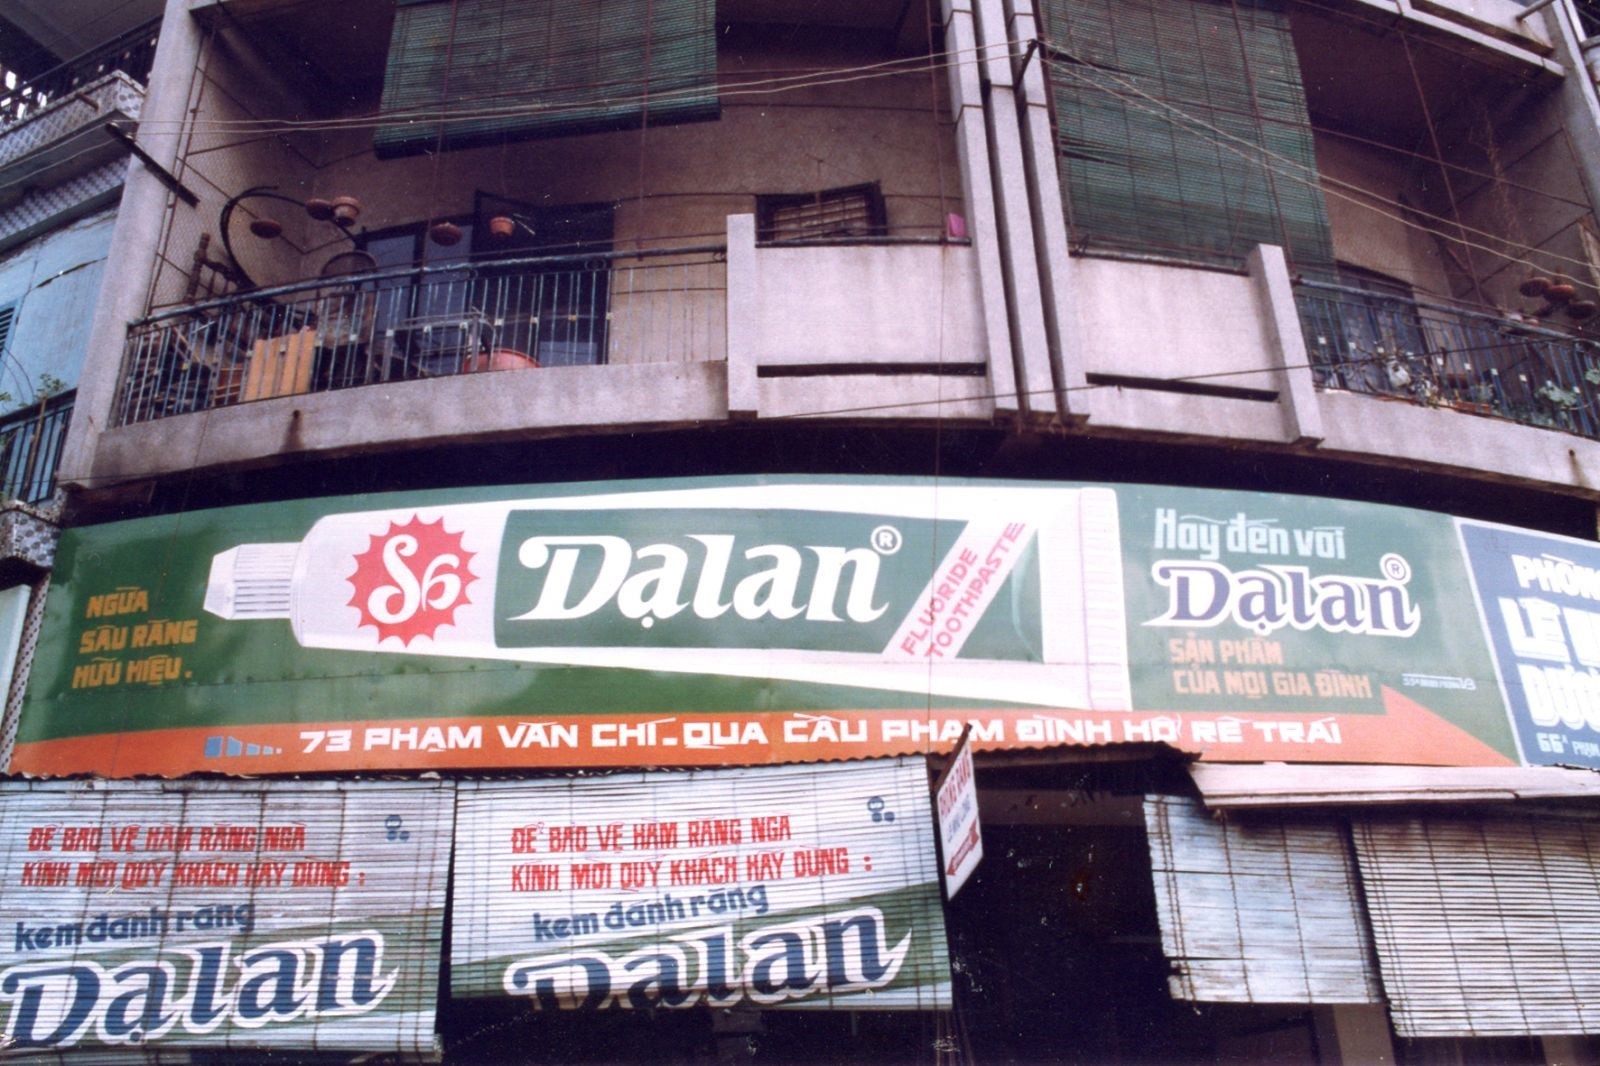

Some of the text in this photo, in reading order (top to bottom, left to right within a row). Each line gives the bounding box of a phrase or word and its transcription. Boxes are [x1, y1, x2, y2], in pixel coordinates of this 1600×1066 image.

[900, 547, 978, 656] FLUORIDE
[924, 522, 1026, 657] TOOTHPASTE
[1224, 671, 1268, 699] MỌI
[1273, 672, 1313, 697] GIA
[299, 729, 352, 753] 73
[364, 726, 482, 752] PHẠM
[498, 722, 578, 748] VĂN
[784, 712, 868, 743] CẦU
[881, 718, 1004, 744] PHẠM
[1252, 717, 1342, 744] TRÁI
[15, 921, 83, 951] kem
[533, 912, 599, 941] kem
